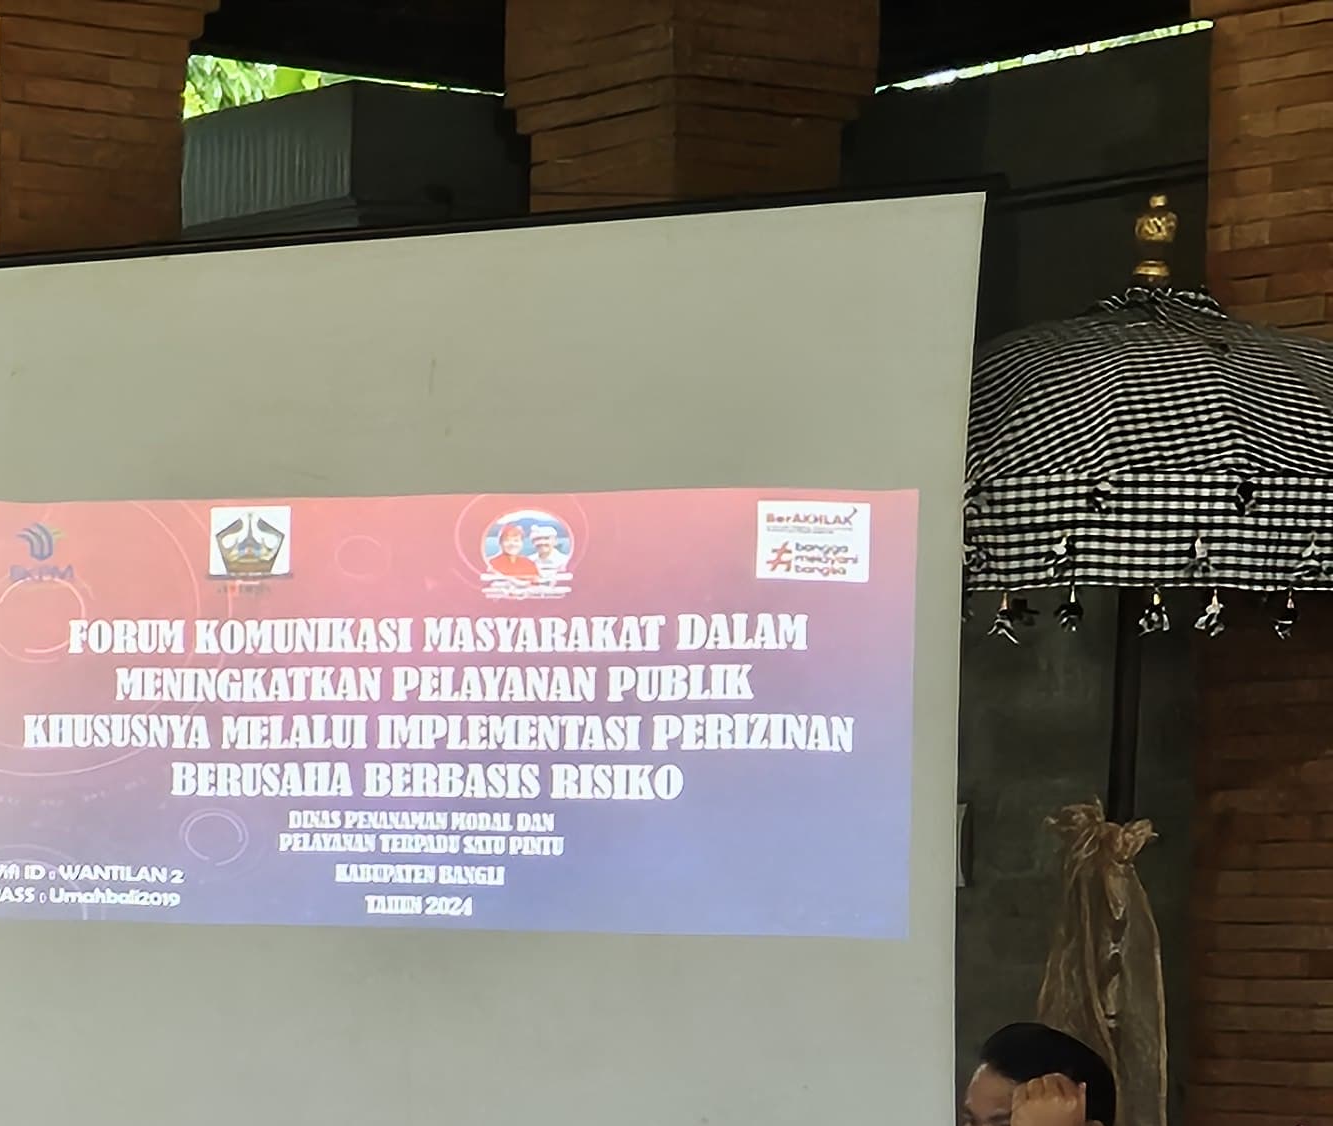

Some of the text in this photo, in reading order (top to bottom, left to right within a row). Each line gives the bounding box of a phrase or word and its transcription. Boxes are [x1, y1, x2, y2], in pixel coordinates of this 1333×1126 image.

[68, 612, 809, 655] FORUM KOMUNIKASI MASYARAKAT DALAM
[115, 663, 755, 702] MENINGKATKAN PELAYANAN PUBLIK
[23, 713, 855, 753] KHUSUSNYA MELALUI IMPLEMENTASI PERIZINAN
[170, 761, 684, 801] BERUSAHA BERBASIS RISIKO
[288, 810, 555, 832] DINAS PENANAMAN MODAL DAN
[278, 833, 565, 856] PELAYANAN TERPADU SATU PINTU
[24, 864, 46, 880] ID
[58, 864, 168, 882] WANTILAN
[170, 869, 185, 884] 2
[335, 863, 506, 886] KABUPATEN BANGLI
[365, 895, 473, 916] TAHUN 2024
